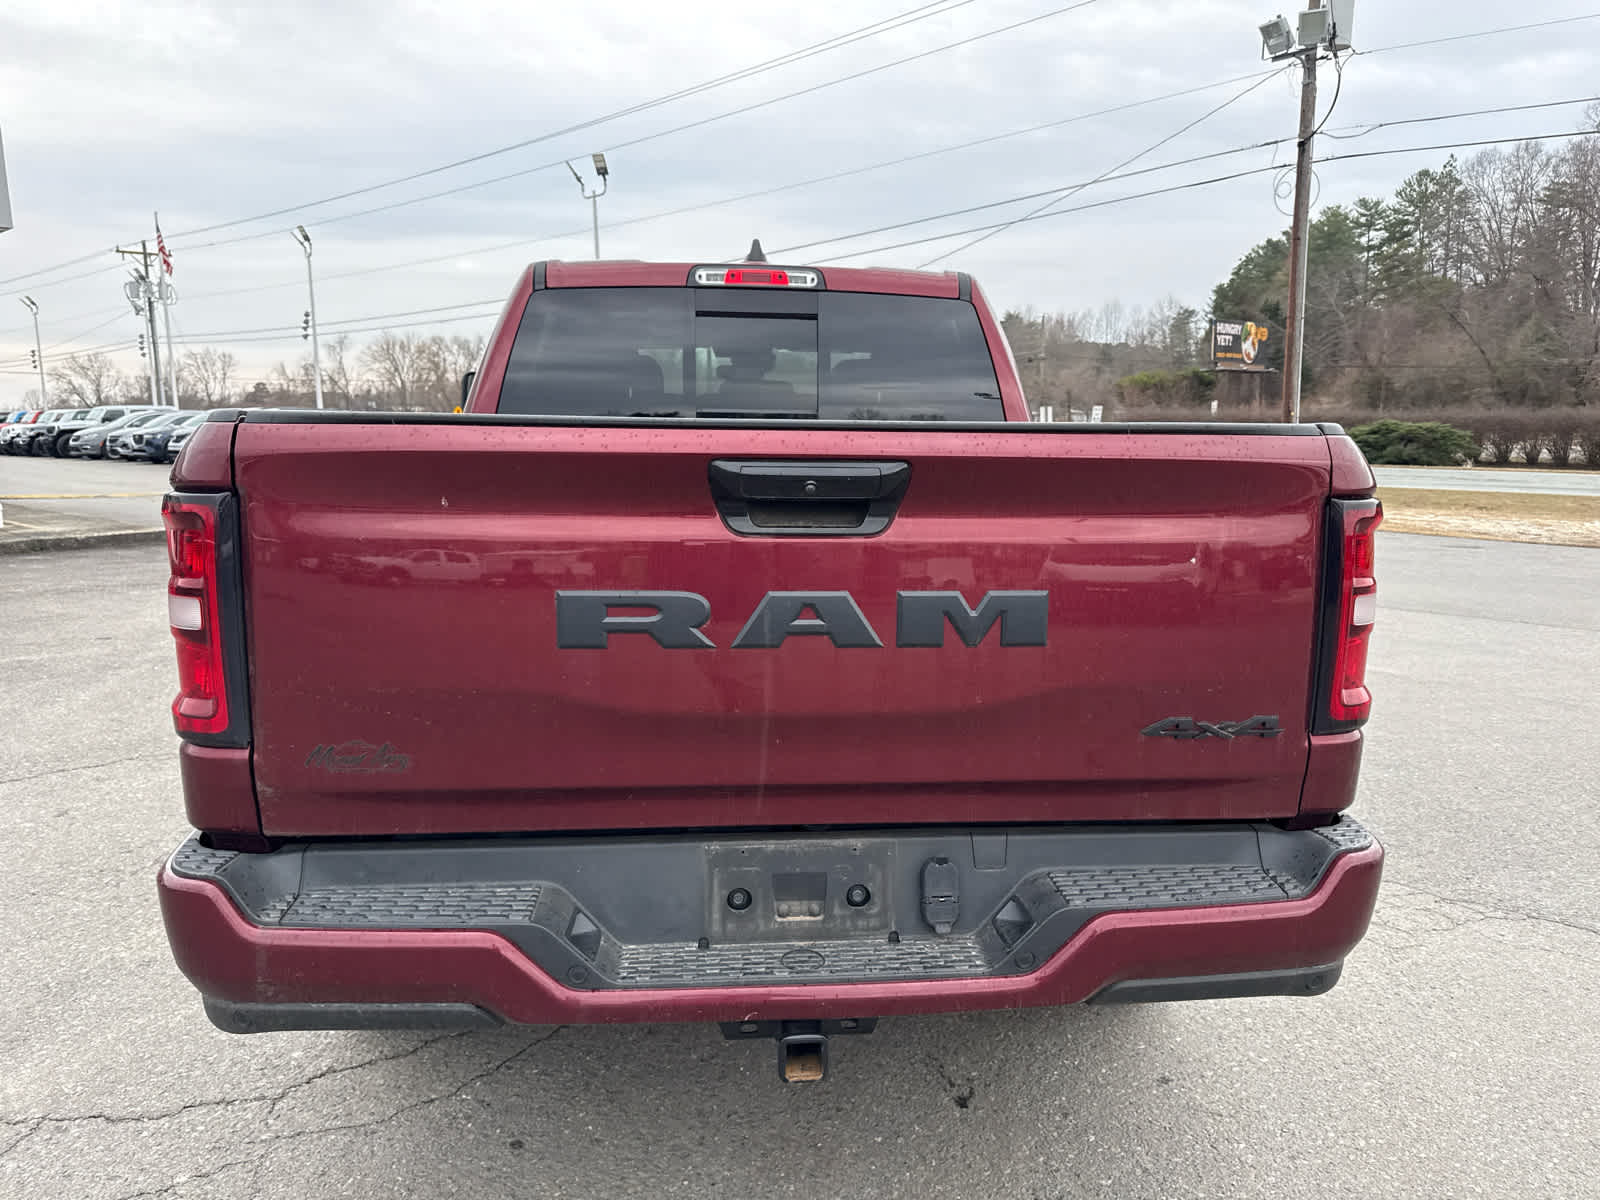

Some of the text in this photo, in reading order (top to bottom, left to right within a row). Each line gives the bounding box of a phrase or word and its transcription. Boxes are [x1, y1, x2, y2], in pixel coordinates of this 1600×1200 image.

[1216, 322, 1242, 335] HUNGRY
[1216, 335, 1233, 347] YET?
[555, 589, 1049, 649] RAM
